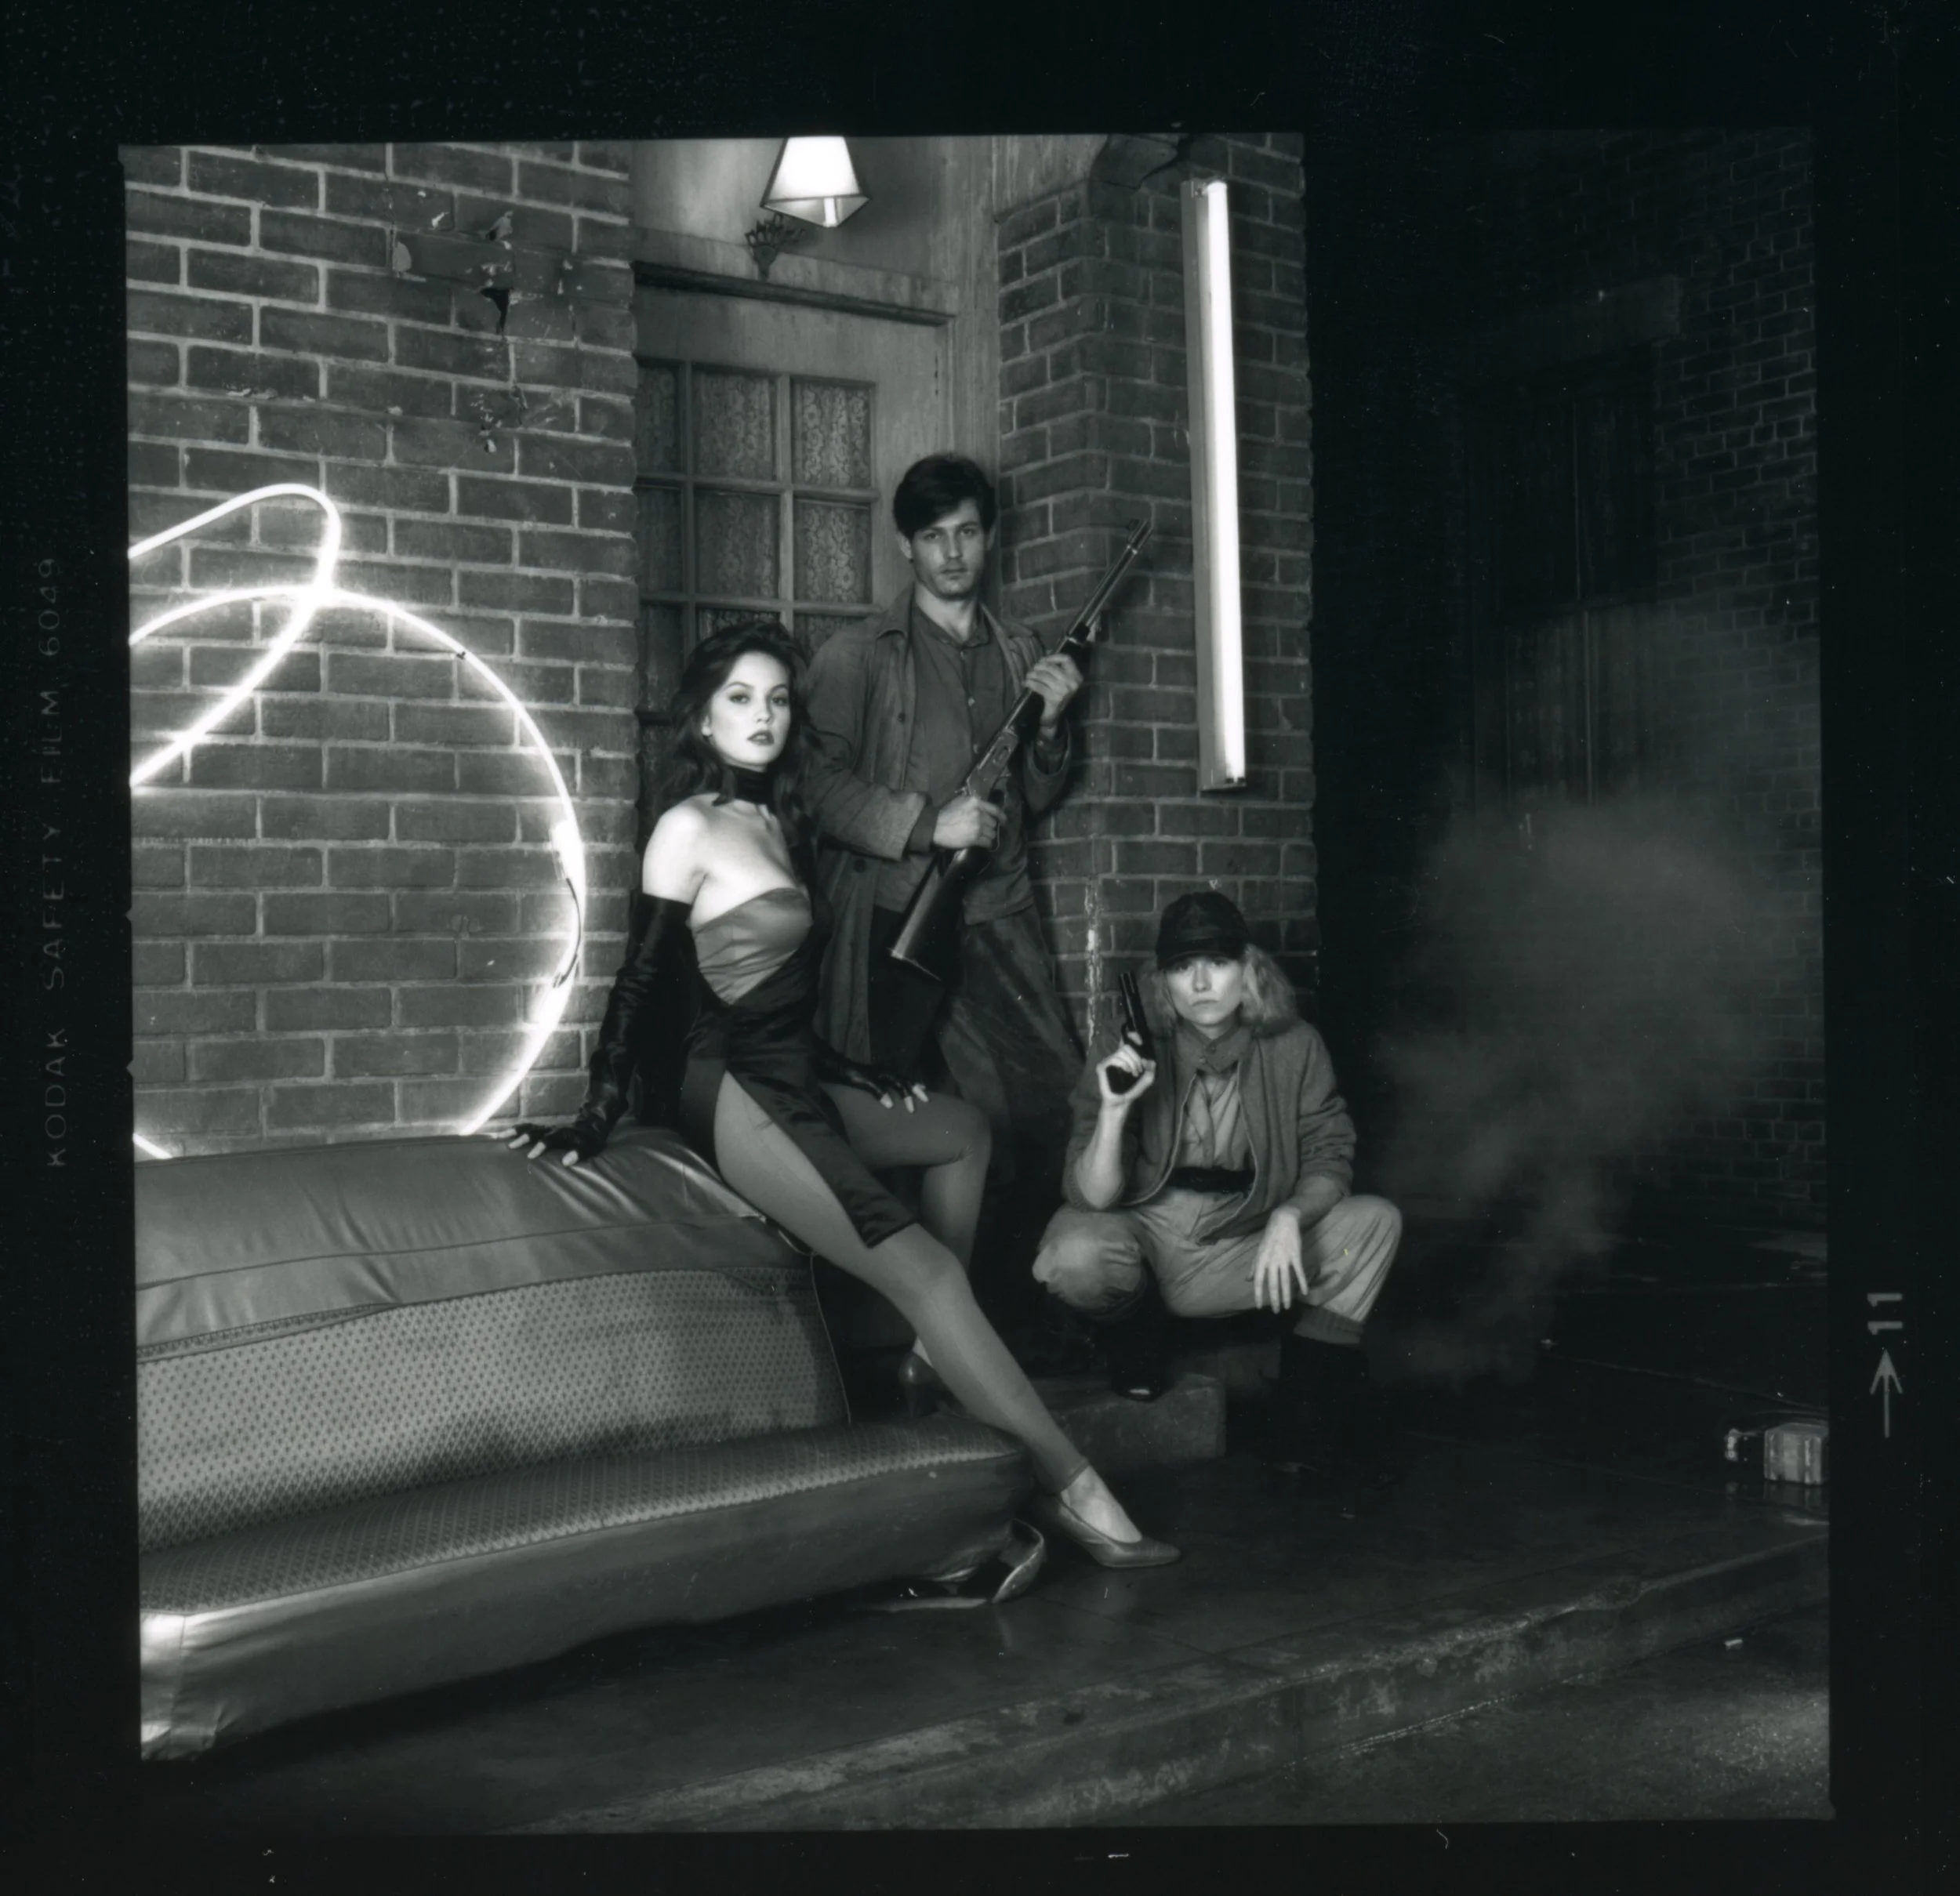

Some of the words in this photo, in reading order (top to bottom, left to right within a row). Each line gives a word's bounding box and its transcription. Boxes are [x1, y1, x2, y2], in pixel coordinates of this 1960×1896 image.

[37, 558, 61, 657] 6049
[39, 690, 62, 784] FILM
[40, 825, 66, 990] SAFETY
[44, 1028, 67, 1167] KODAK
[1867, 1292, 1904, 1335] 11
